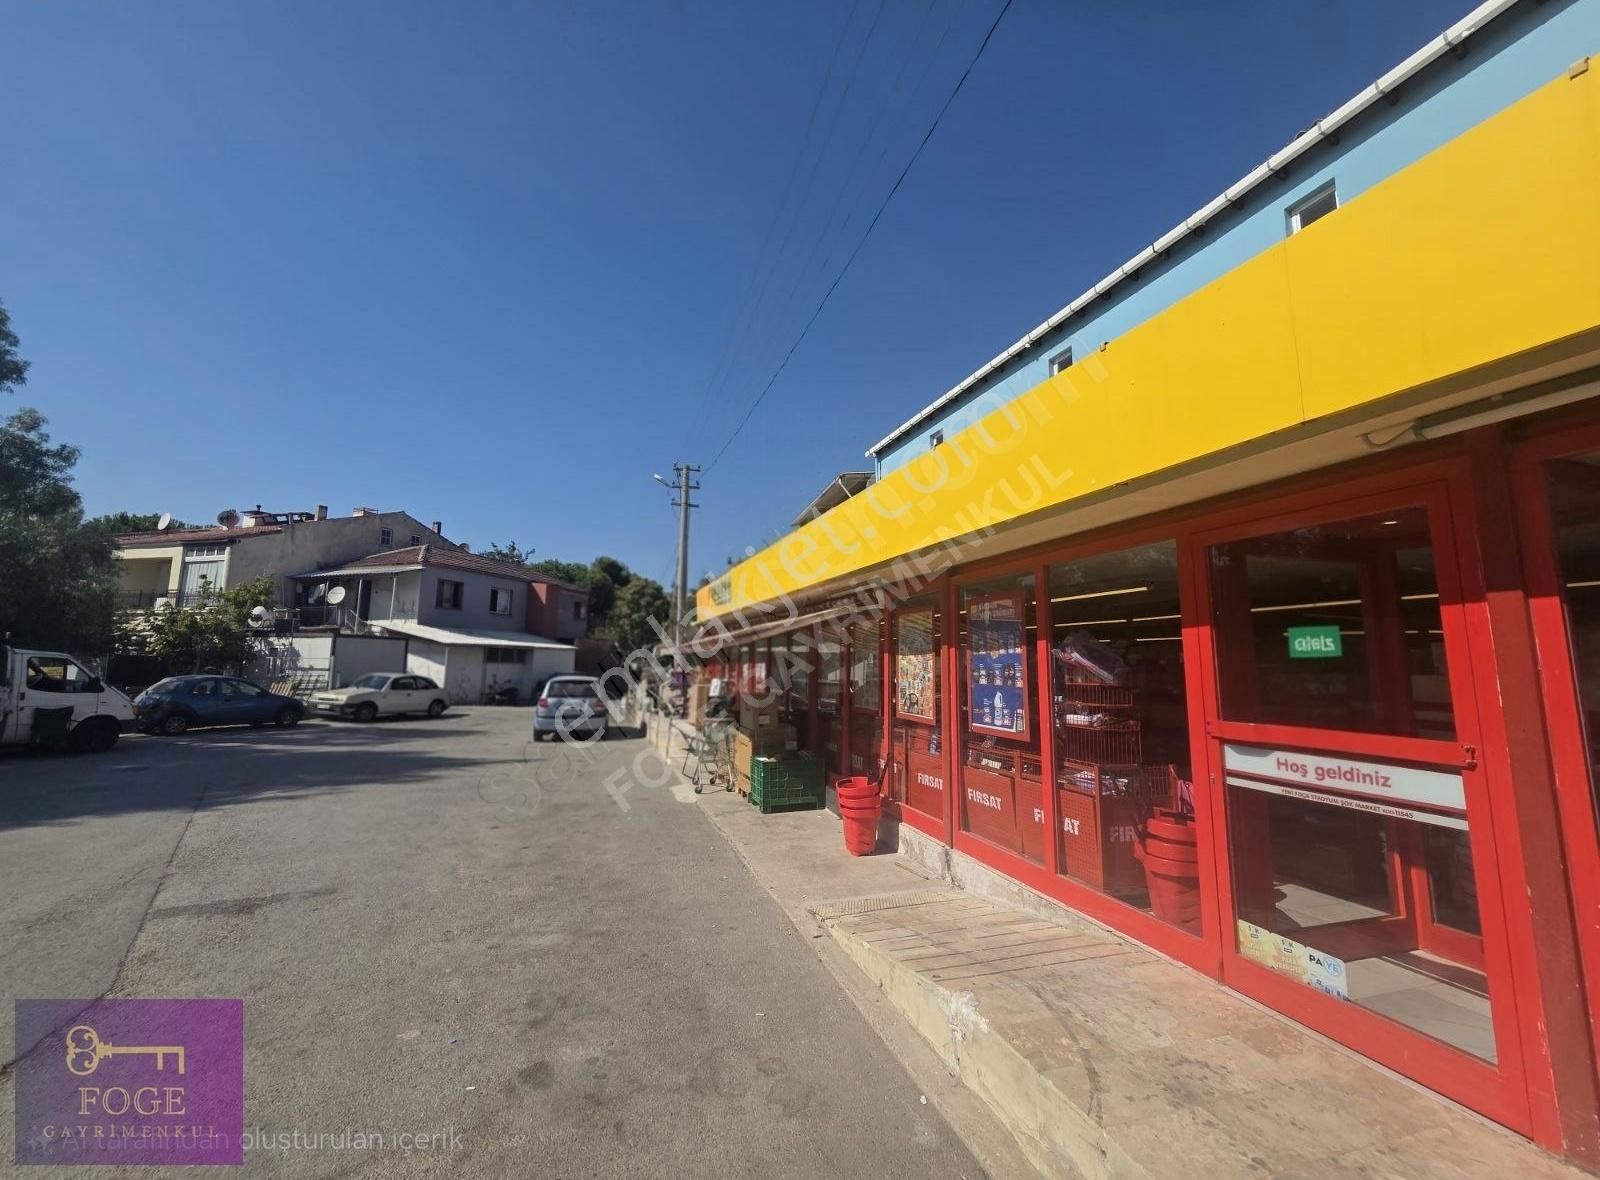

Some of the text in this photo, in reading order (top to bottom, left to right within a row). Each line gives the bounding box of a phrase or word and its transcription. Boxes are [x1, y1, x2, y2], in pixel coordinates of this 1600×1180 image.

[1276, 757, 1392, 788] Hoş geldiniz
[967, 788, 1002, 810] FIRSAT
